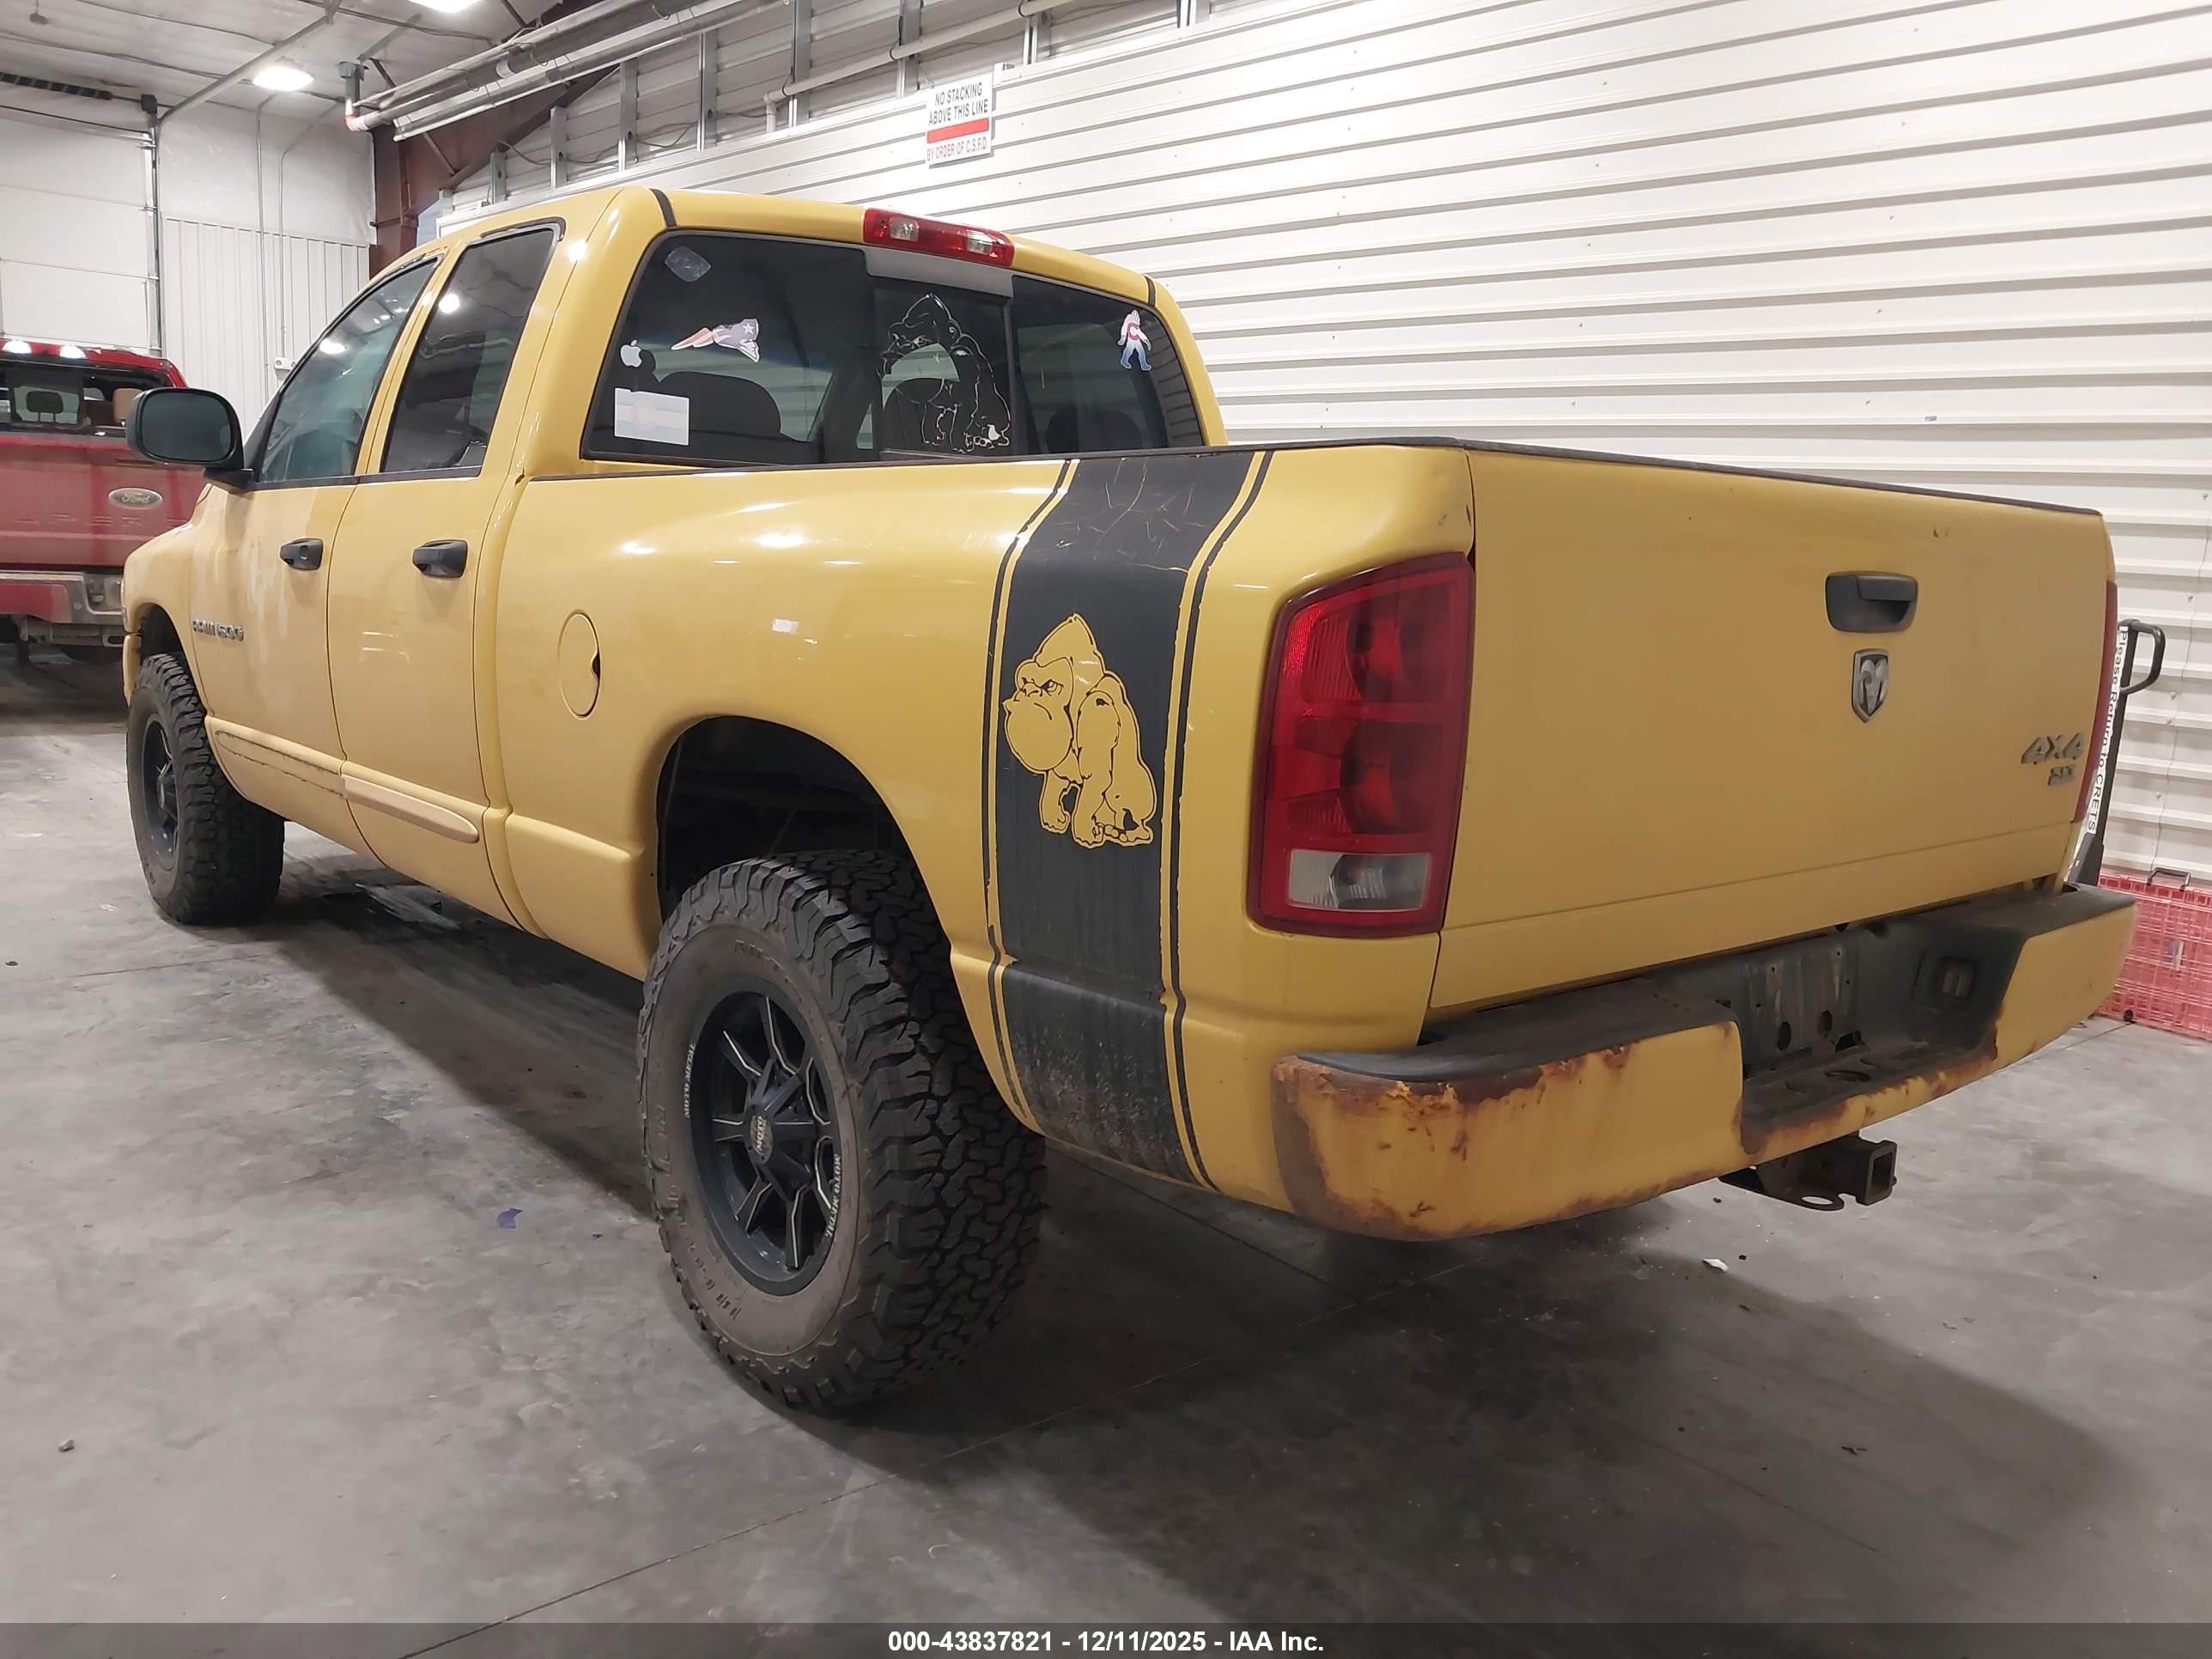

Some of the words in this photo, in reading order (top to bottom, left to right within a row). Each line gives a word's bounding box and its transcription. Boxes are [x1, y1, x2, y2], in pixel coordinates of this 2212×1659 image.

[935, 92, 945, 106] NO
[946, 82, 982, 104] STACKING
[929, 107, 951, 125] ABOVE
[954, 103, 969, 120] THIS
[971, 99, 988, 117] LINE
[927, 149, 934, 161] BY
[936, 143, 955, 160] ORDER
[956, 141, 964, 155] OF
[2112, 631, 2128, 685] Please
[2103, 691, 2118, 747] Return
[2098, 752, 2108, 769] to
[2087, 774, 2104, 831] CRETS
